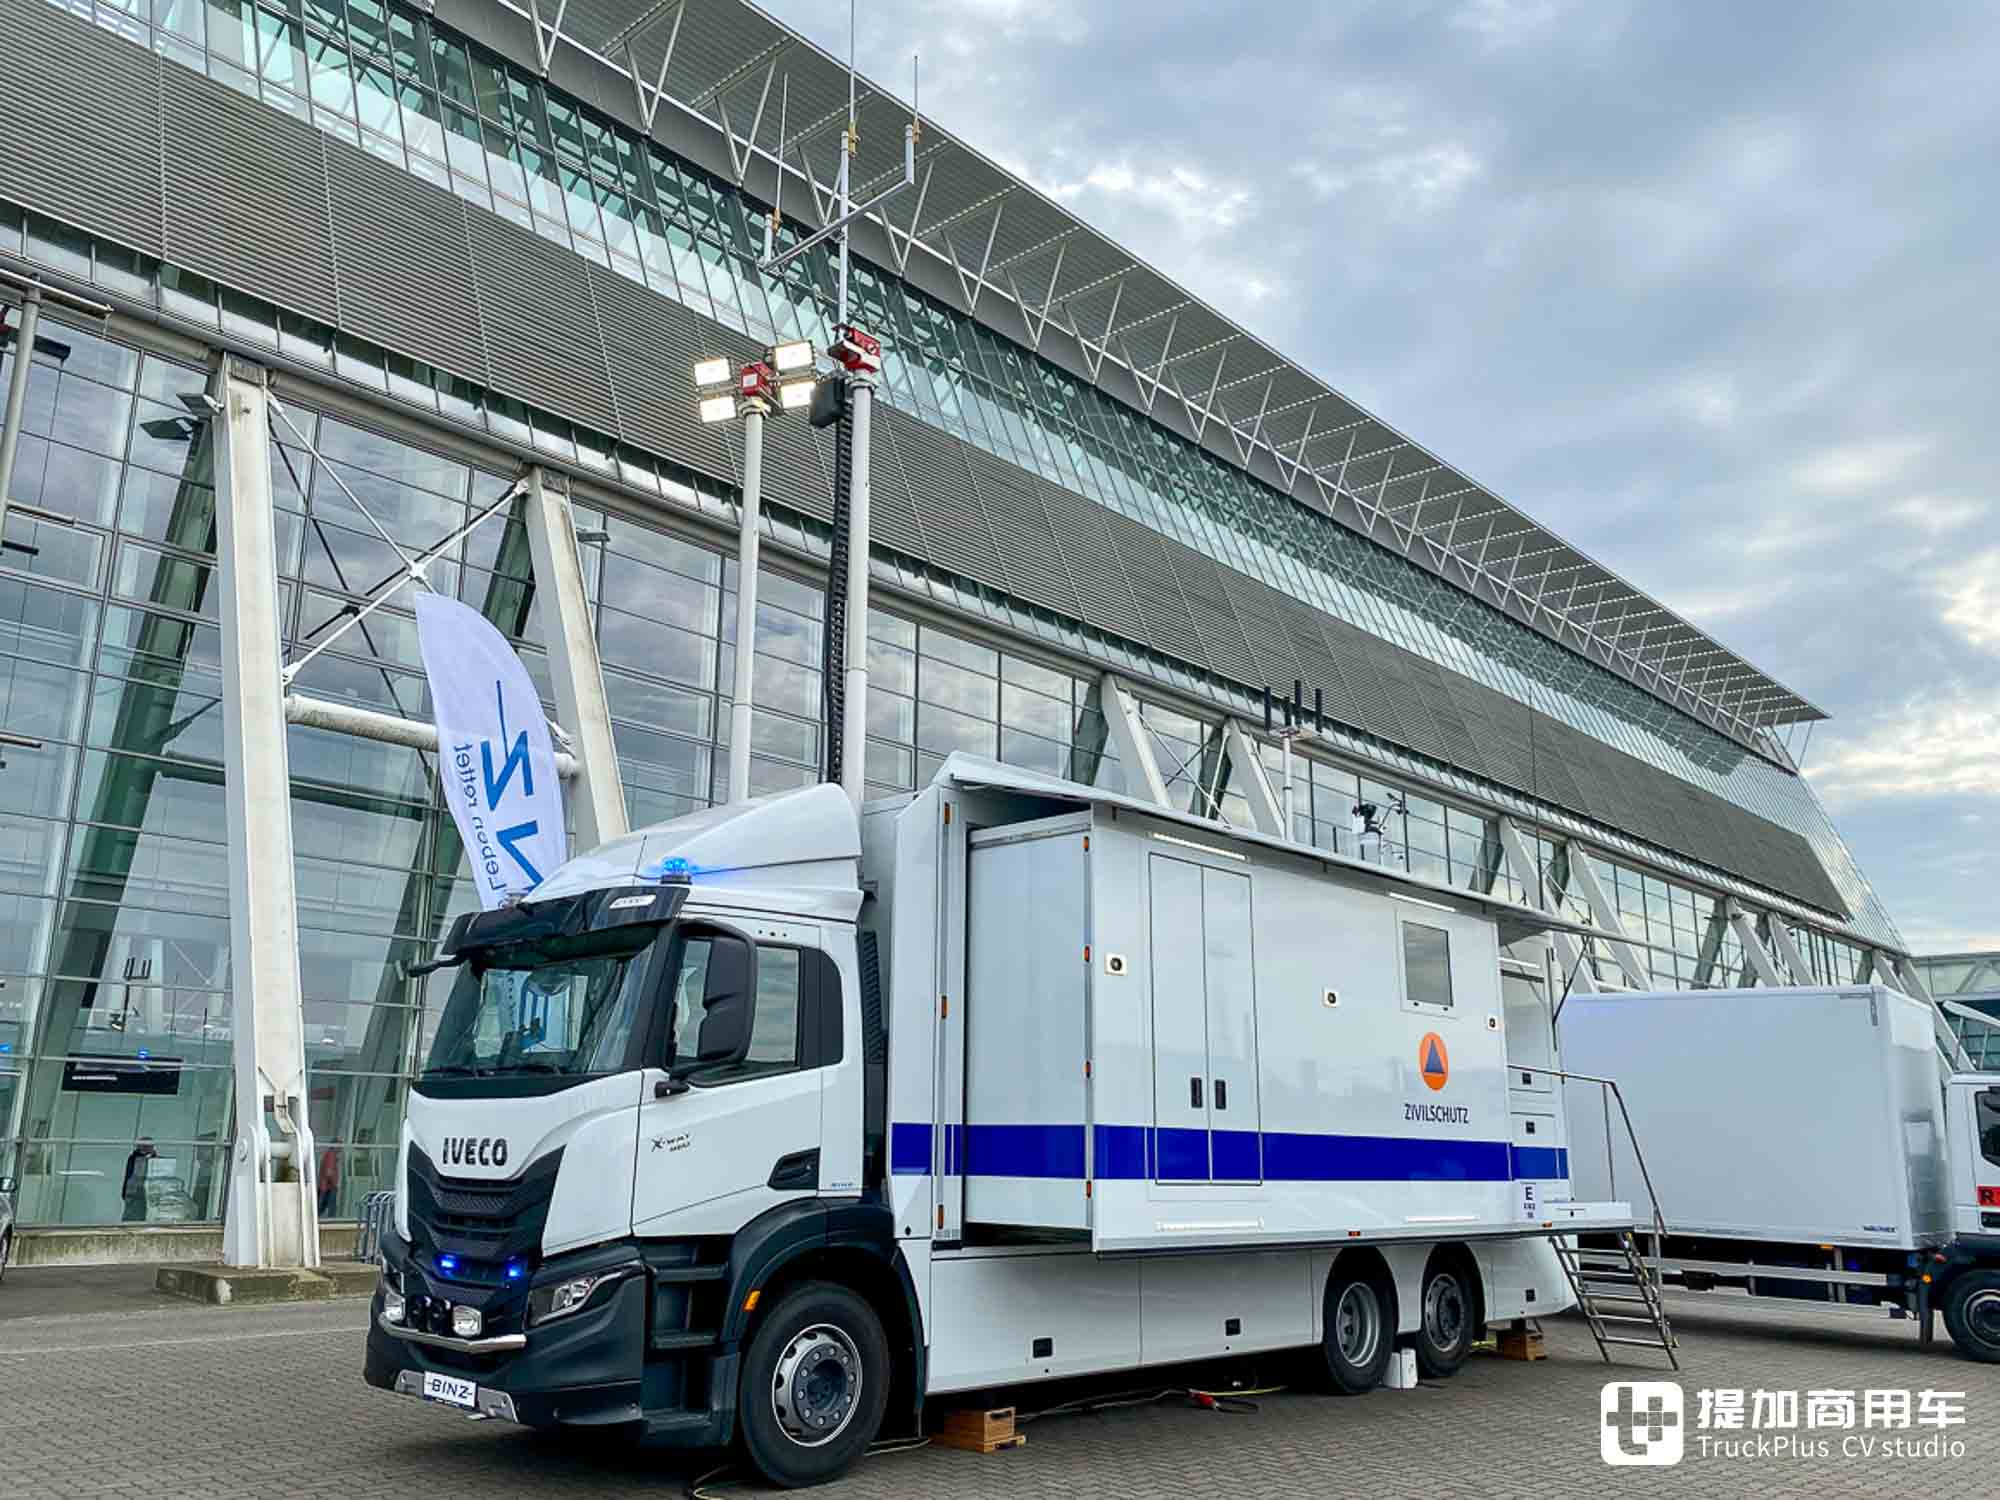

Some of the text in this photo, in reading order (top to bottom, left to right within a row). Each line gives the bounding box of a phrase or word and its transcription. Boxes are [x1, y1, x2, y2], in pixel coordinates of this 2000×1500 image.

[1404, 1103, 1470, 1124] ZIVILSCHUTZ
[443, 1137, 507, 1166] IVECO
[1525, 1186, 1534, 1200] E
[432, 1378, 469, 1399] BINZ
